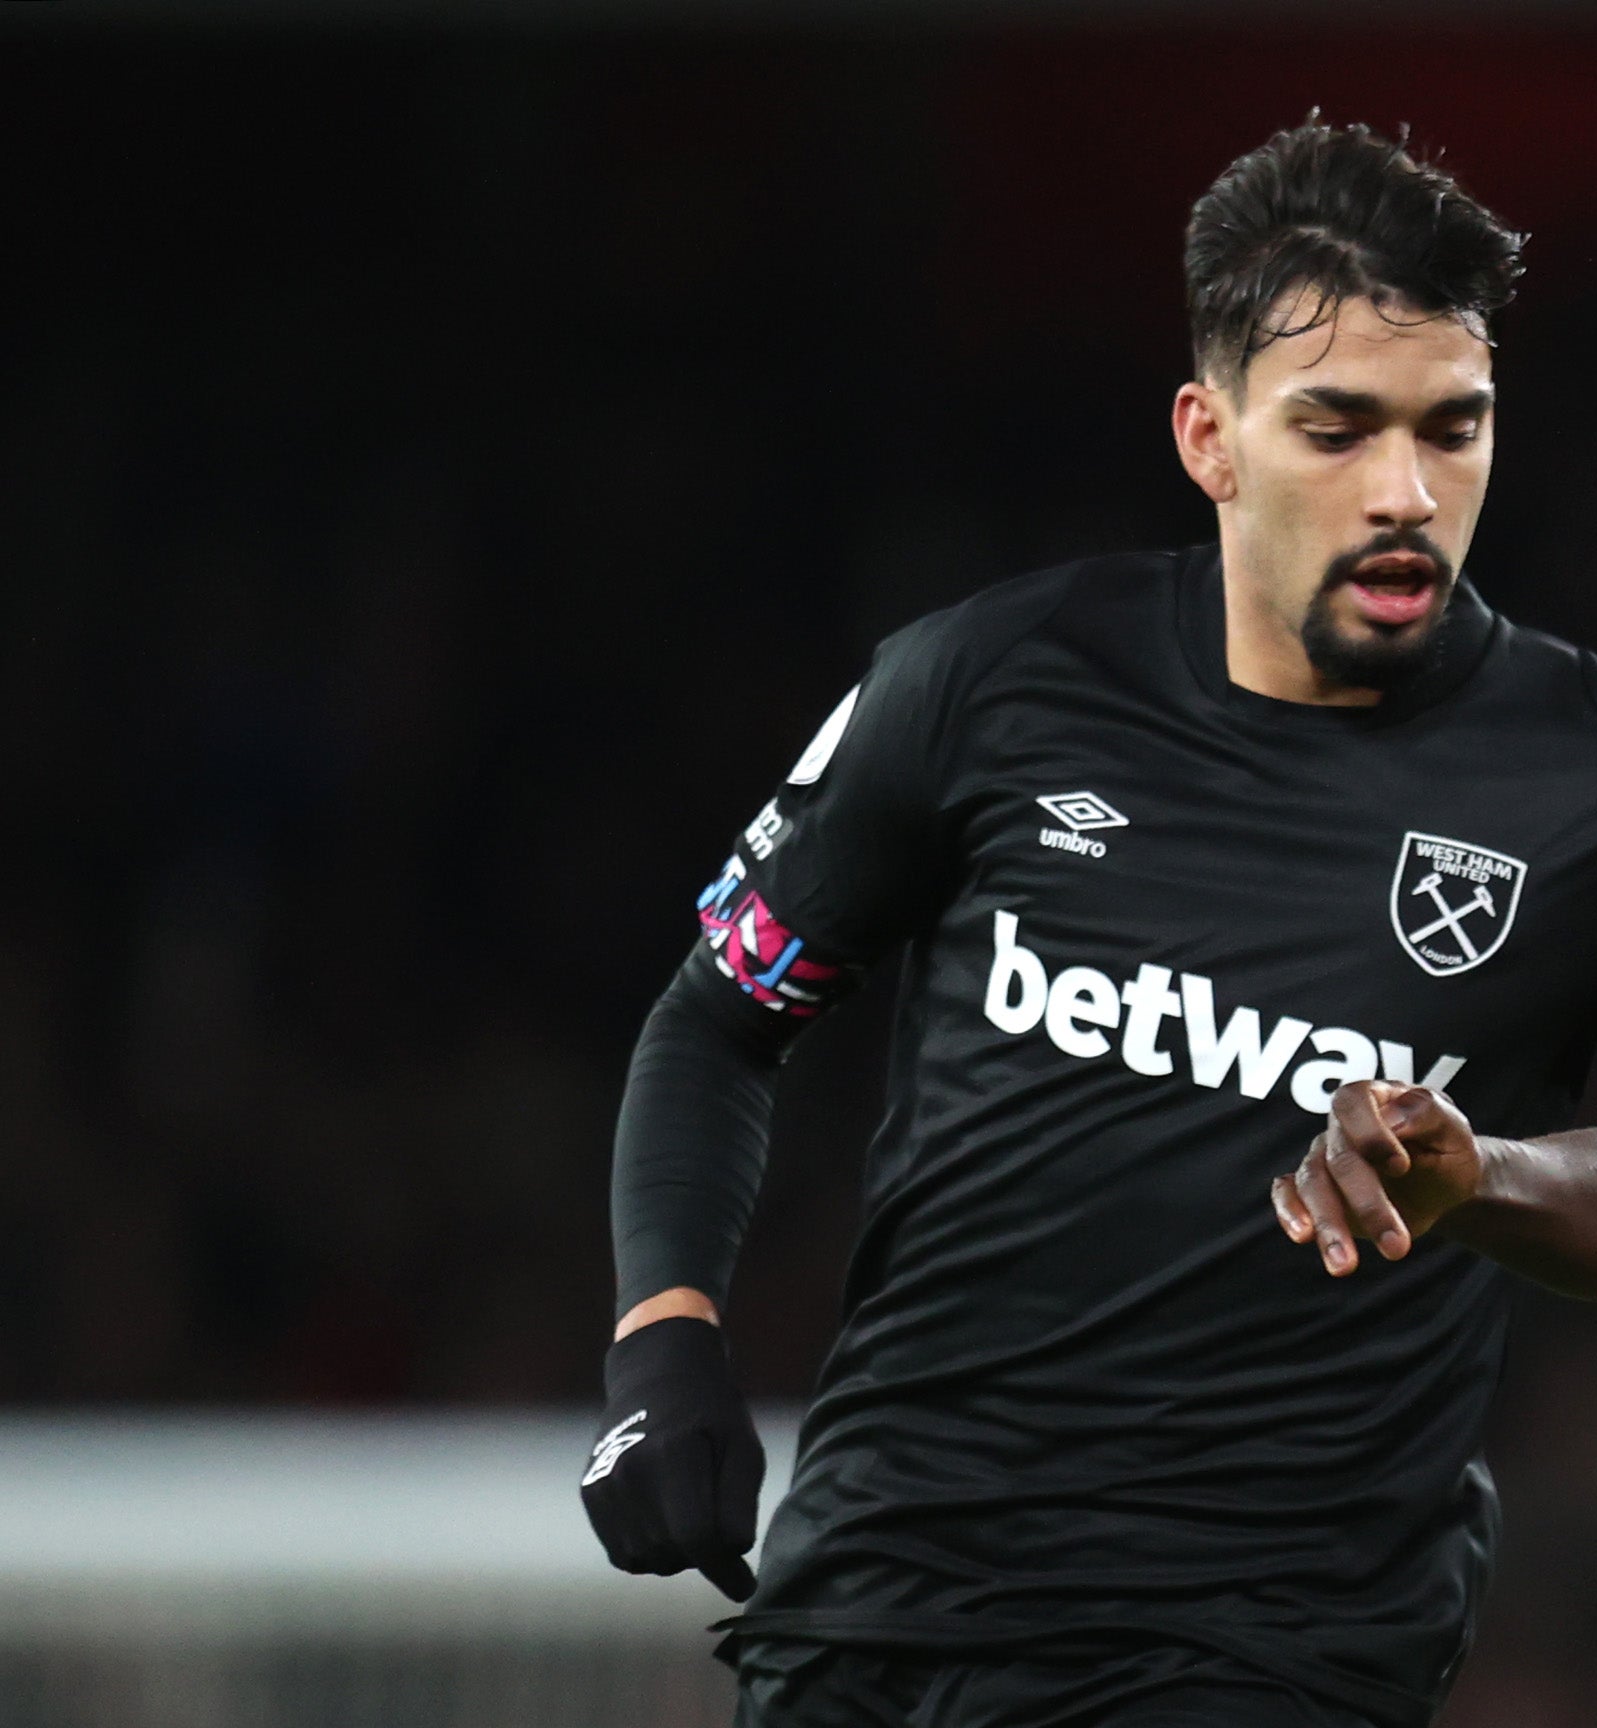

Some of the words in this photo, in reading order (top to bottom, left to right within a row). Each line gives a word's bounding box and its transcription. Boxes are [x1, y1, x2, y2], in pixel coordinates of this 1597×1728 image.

[1039, 828, 1106, 859] umbro
[1415, 841, 1467, 863] WEST
[1467, 853, 1512, 881] HAM
[1432, 859, 1490, 883] UNITED
[1420, 944, 1464, 965] LONDON
